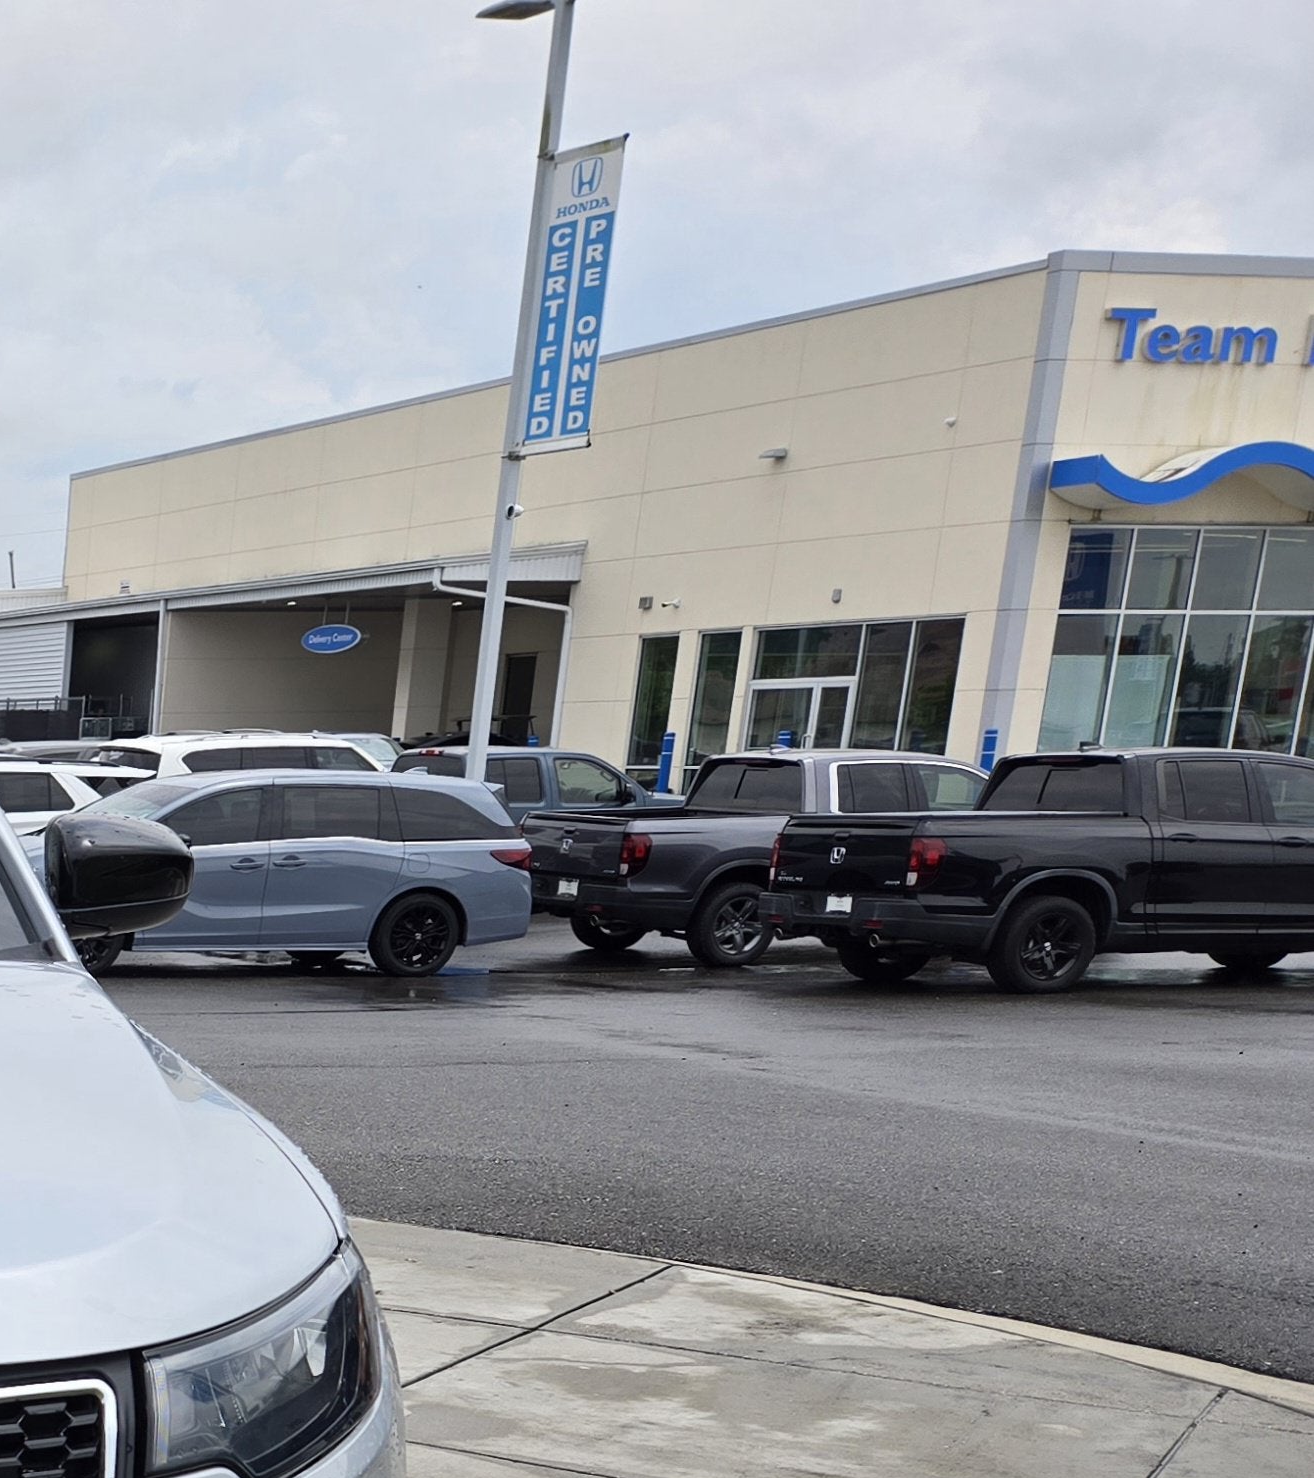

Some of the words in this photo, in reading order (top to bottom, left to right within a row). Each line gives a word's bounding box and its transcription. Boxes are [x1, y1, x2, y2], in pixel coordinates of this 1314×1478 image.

[555, 197, 610, 219] HONDA
[583, 218, 608, 288] PRE
[529, 227, 573, 437] CERTIFIED
[1108, 307, 1278, 364] Team
[566, 315, 599, 431] OWNED
